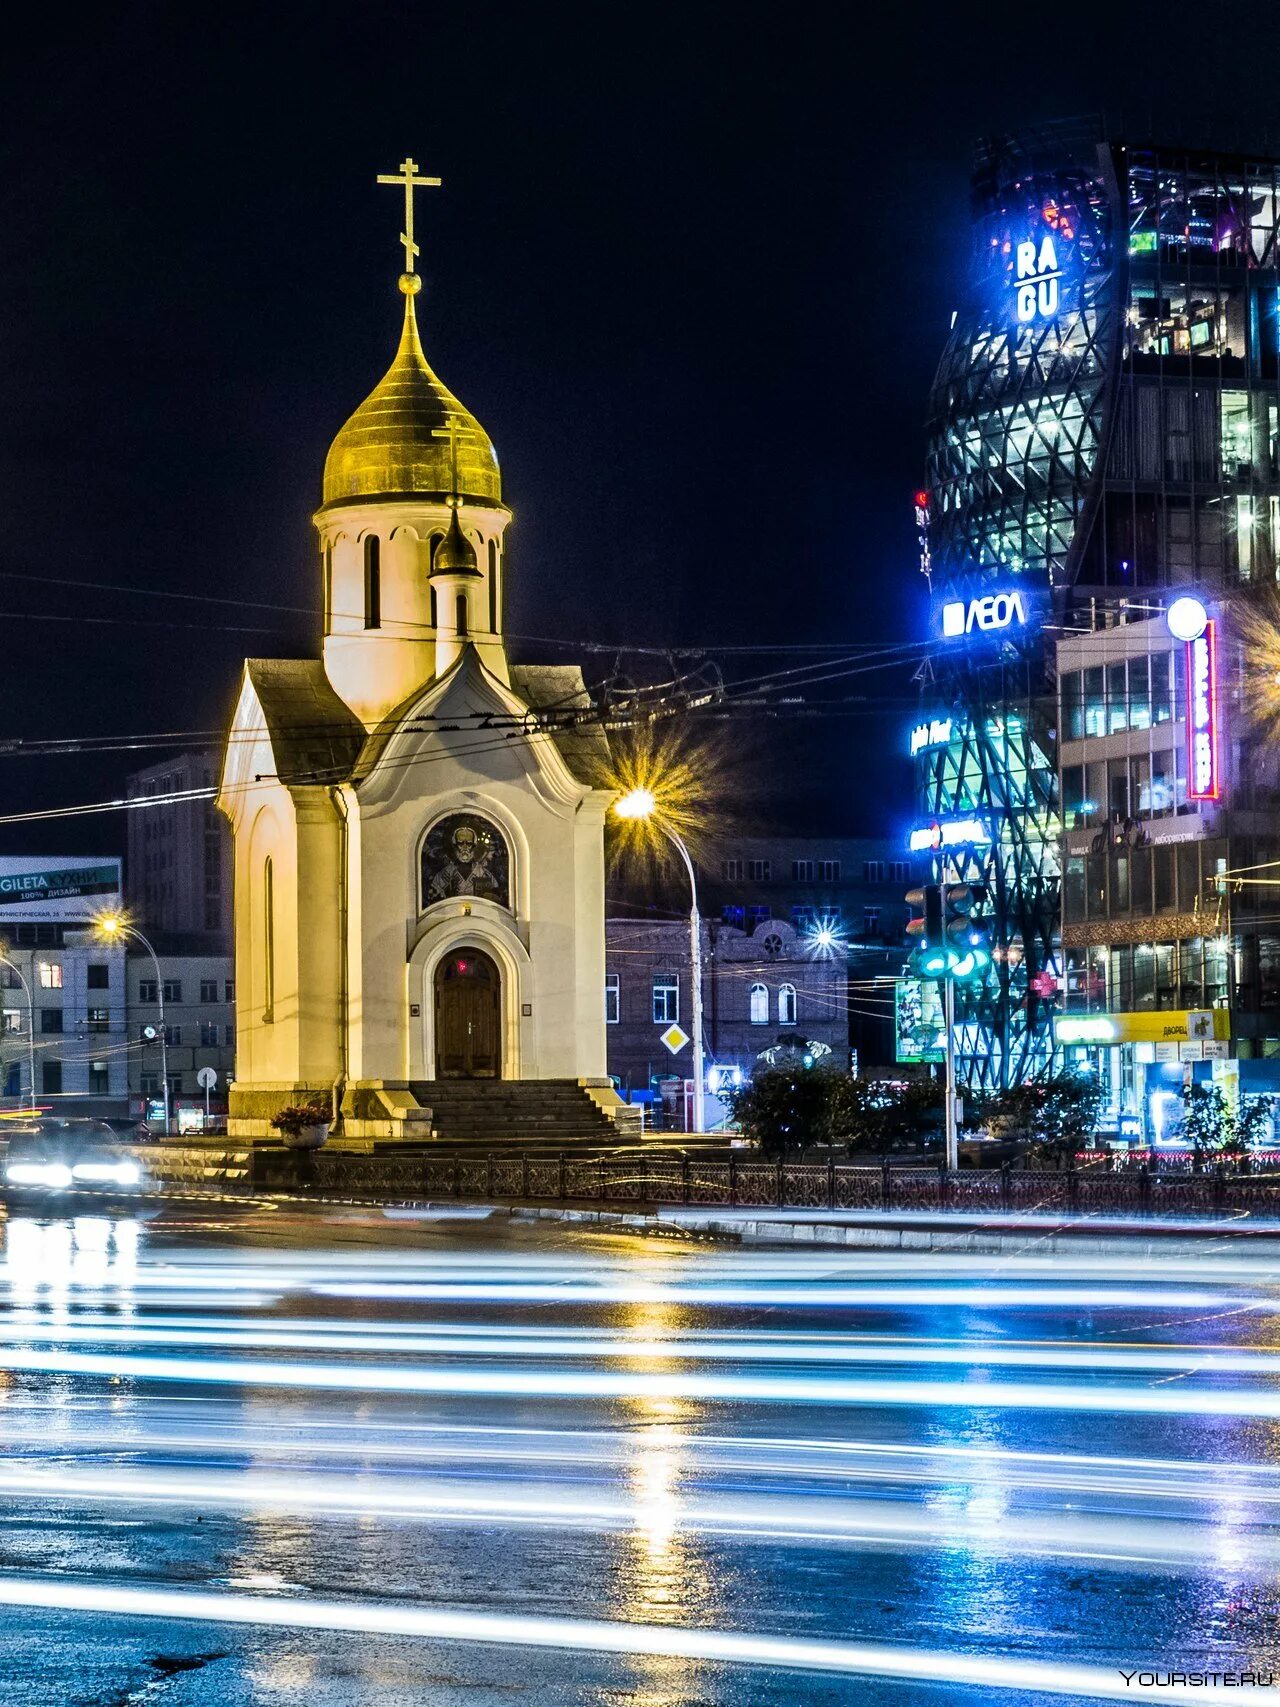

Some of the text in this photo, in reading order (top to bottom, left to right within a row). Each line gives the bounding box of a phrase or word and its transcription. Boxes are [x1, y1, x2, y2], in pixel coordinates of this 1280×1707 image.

[1017, 236, 1058, 279] RA
[1017, 278, 1058, 322] GU
[0, 871, 97, 891] GILETA КУХНИ
[20, 887, 81, 900] 100% ДИЗАЙН
[1163, 1026, 1188, 1037] ДВОРЕЦ
